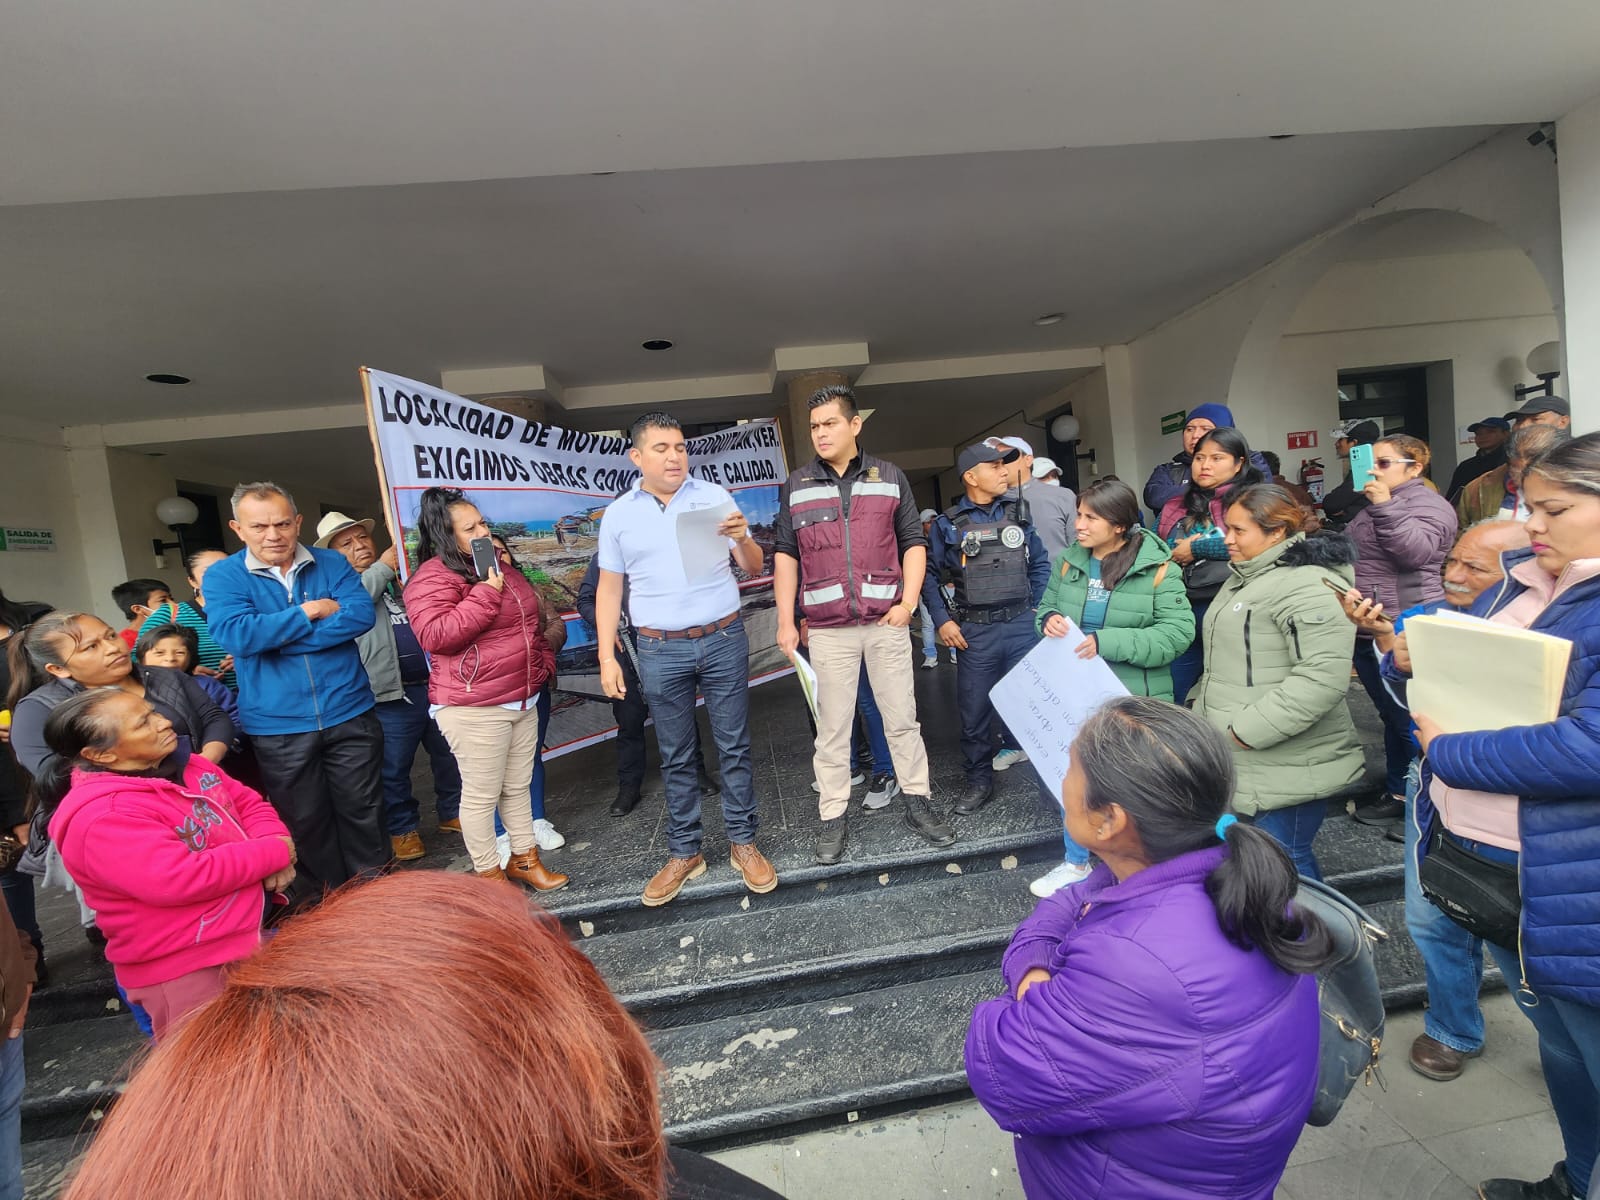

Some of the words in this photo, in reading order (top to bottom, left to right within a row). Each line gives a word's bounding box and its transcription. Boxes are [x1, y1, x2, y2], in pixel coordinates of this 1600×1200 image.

[379, 387, 513, 440] LOCALIDAD
[520, 421, 552, 447] DE
[414, 445, 530, 481] EXIGIMOS
[530, 460, 589, 490] OBRAS
[701, 464, 721, 485] DE
[724, 460, 778, 484] CALIDAD.
[7, 530, 39, 538] SALIDA
